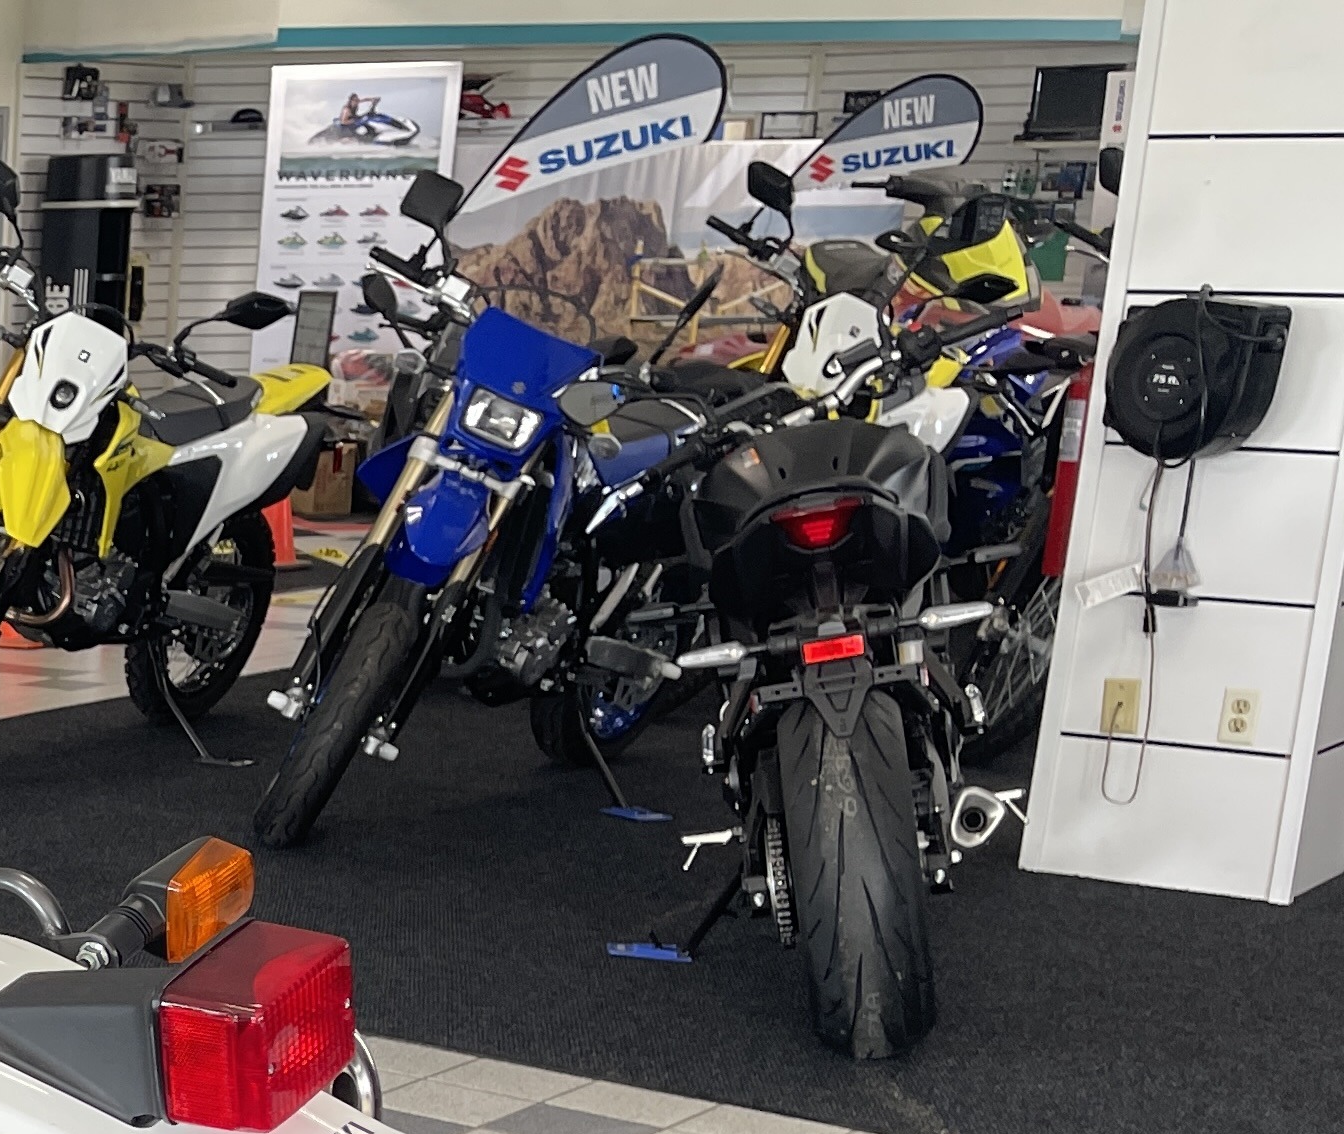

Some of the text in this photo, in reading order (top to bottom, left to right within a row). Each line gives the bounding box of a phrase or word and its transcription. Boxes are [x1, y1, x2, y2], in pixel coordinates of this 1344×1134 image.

[587, 62, 659, 115] NEW
[883, 94, 936, 130] NEW
[538, 115, 693, 175] SUZUKI
[842, 140, 954, 174] SUZUKI
[278, 169, 415, 181] WAVERUNNE
